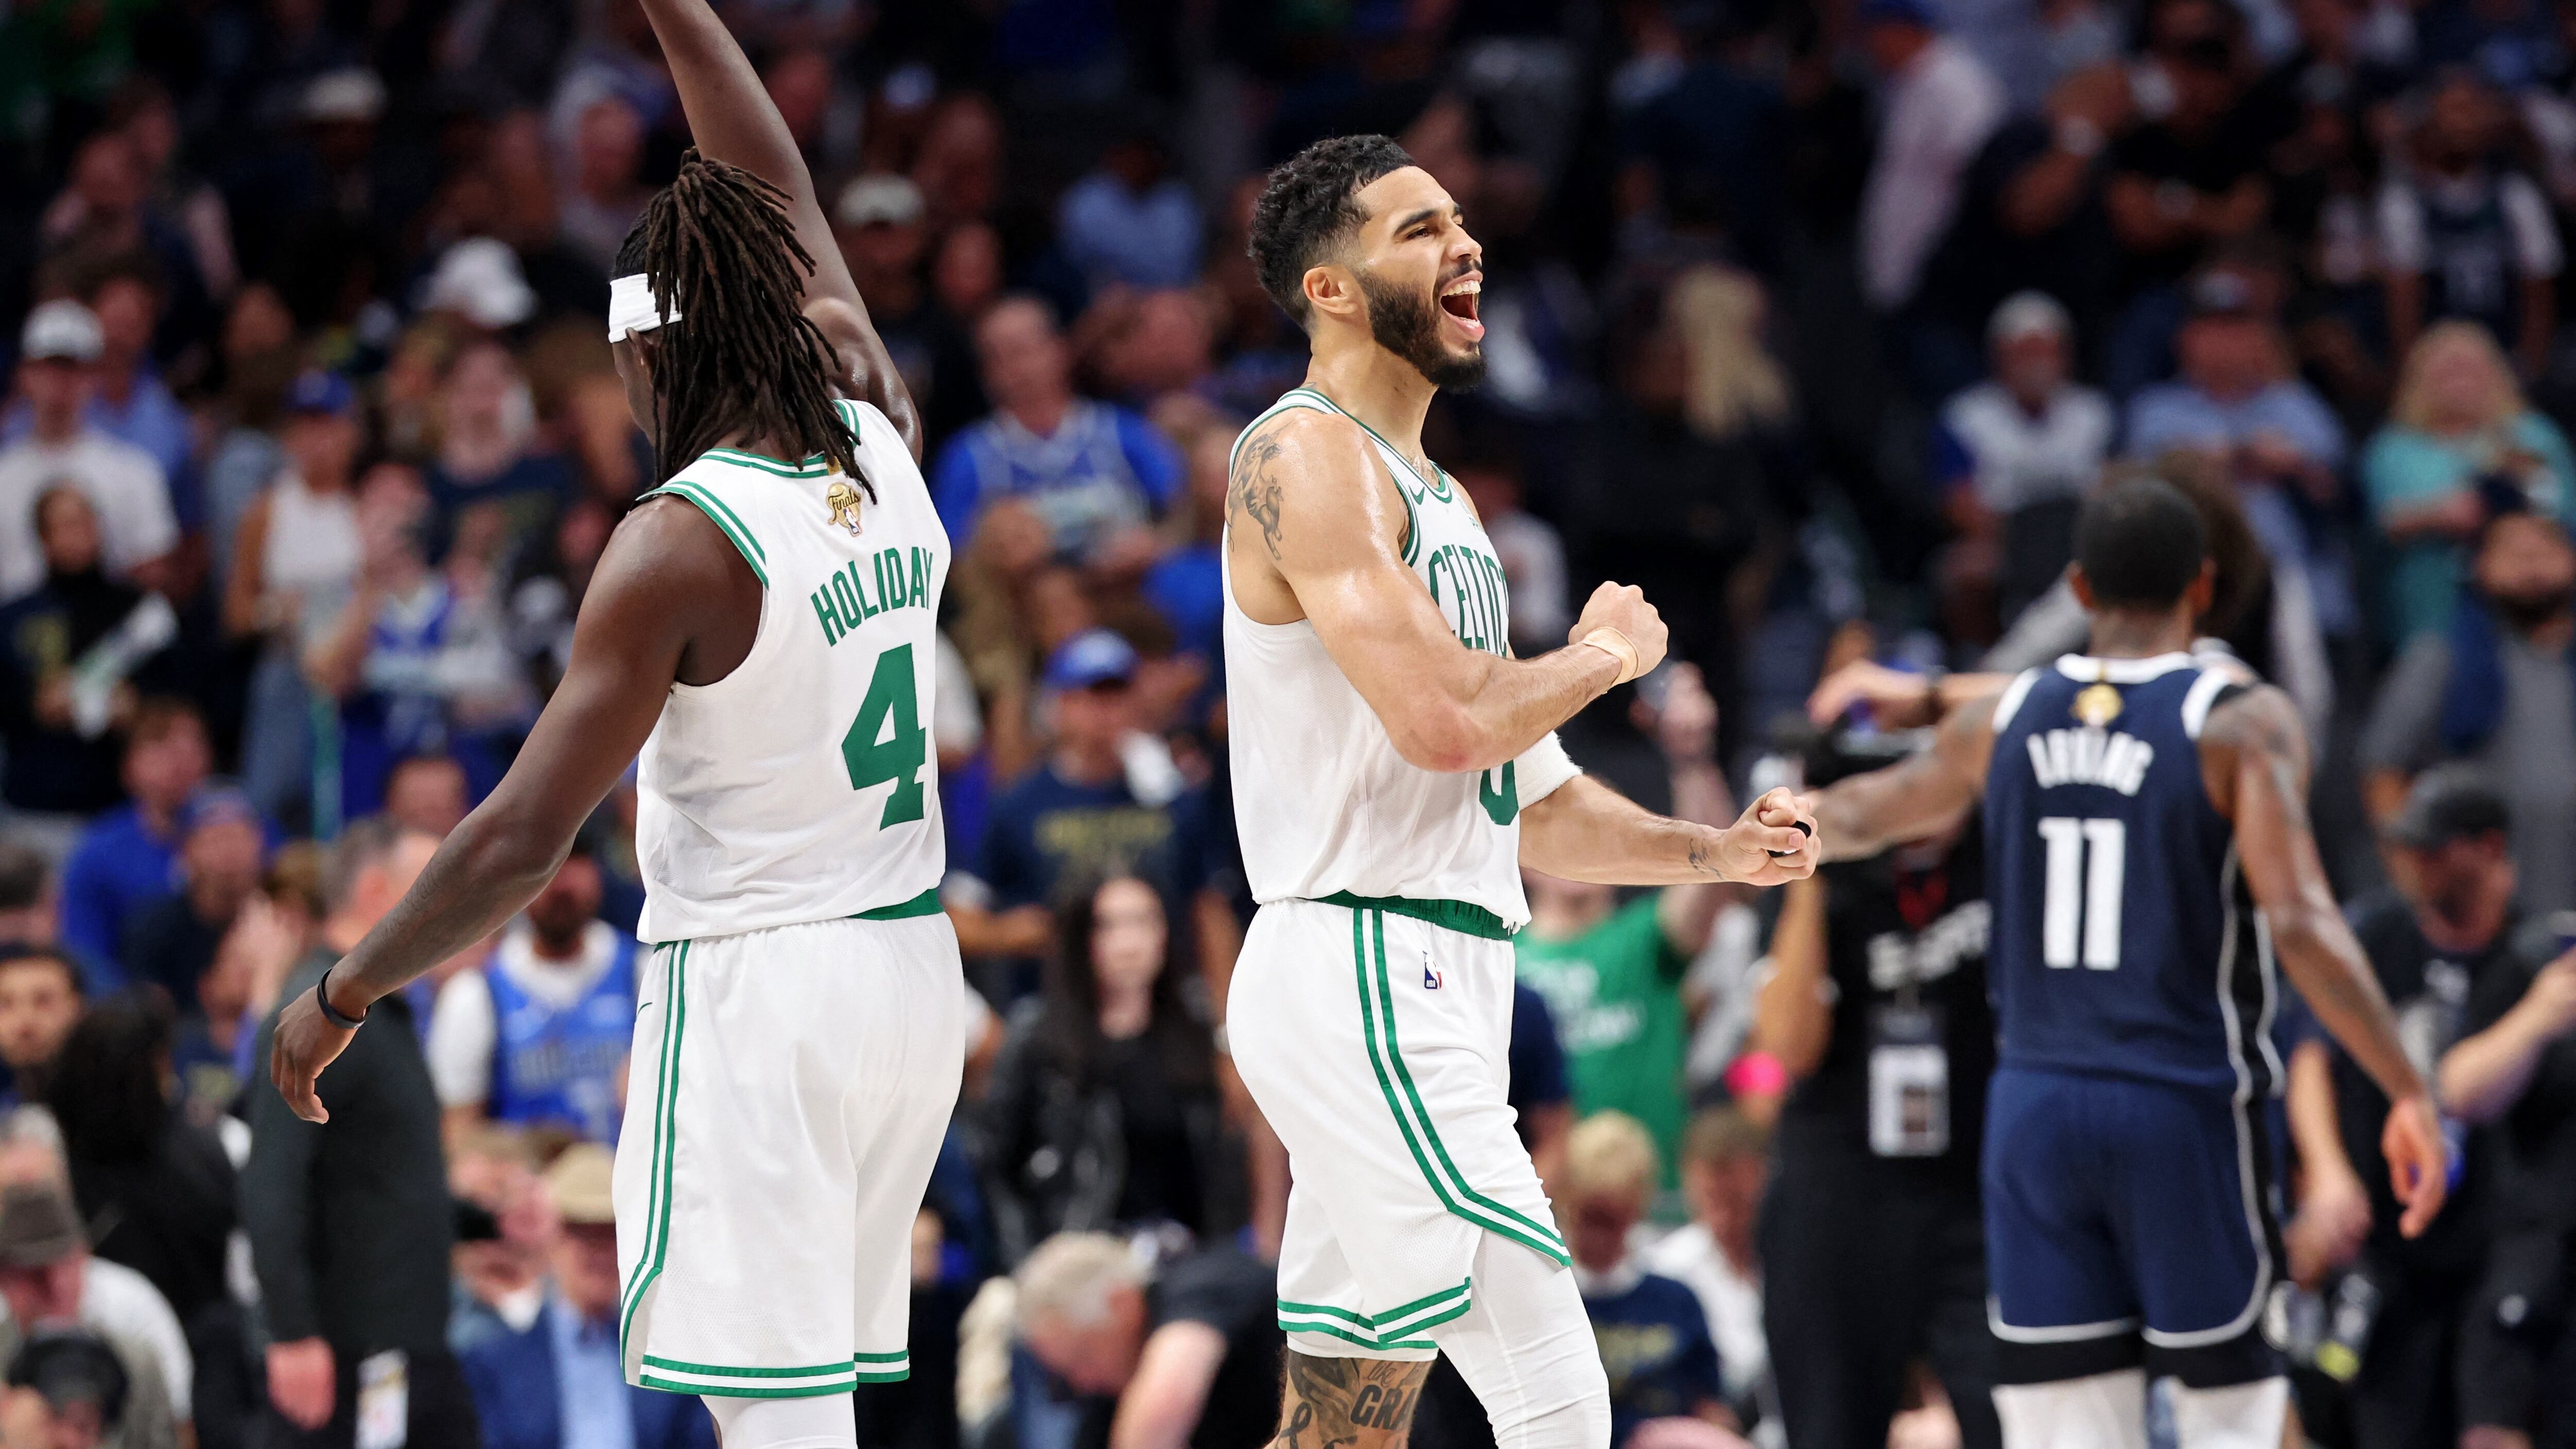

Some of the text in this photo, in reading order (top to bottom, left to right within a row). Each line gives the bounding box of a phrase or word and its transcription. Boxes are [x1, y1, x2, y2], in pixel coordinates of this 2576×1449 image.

[828, 488, 861, 521] Finals
[810, 547, 933, 647] HOLIDAY
[842, 643, 926, 831] 4
[2038, 817, 2126, 970] 11
